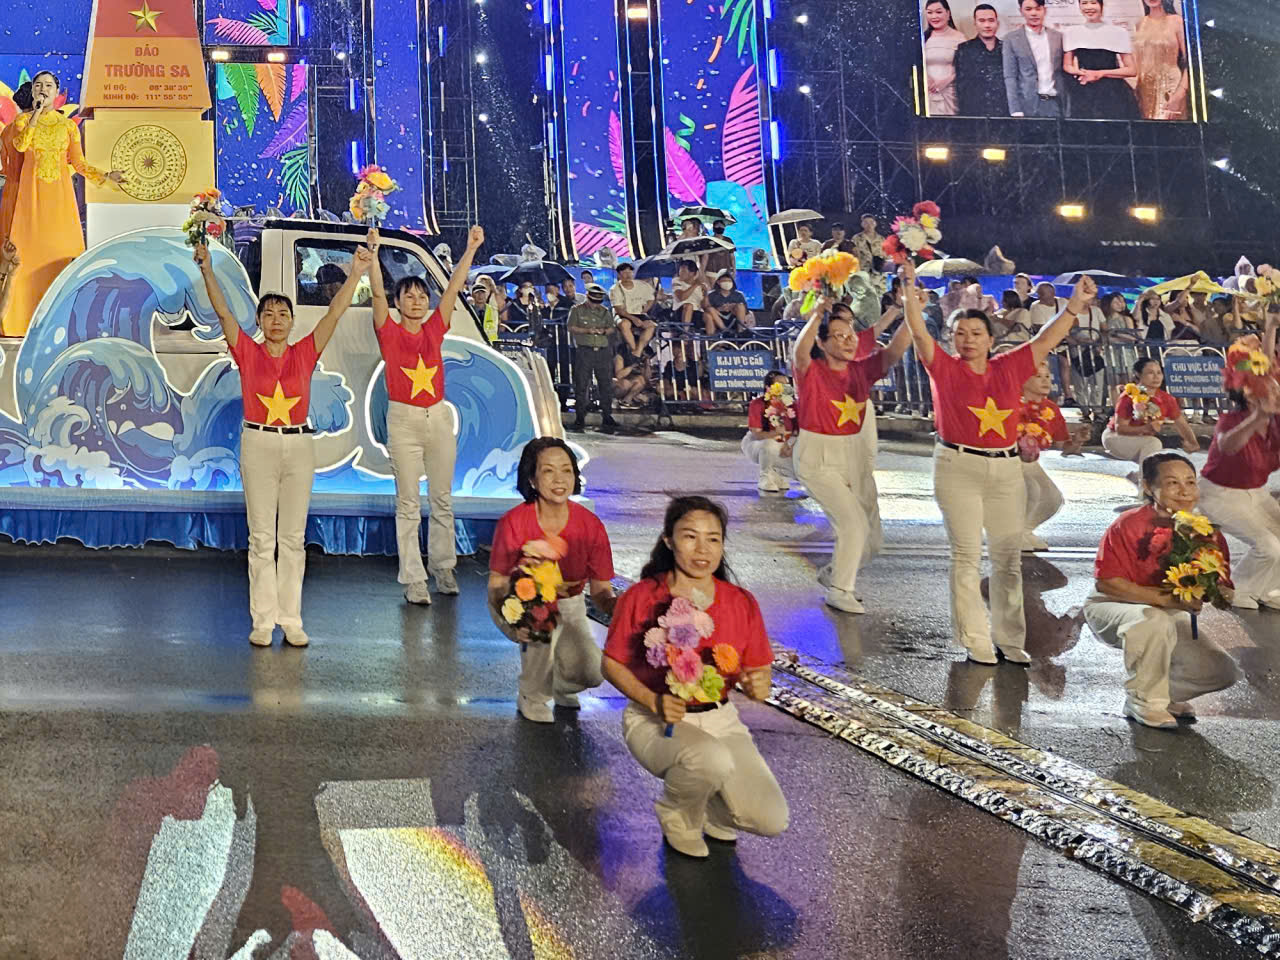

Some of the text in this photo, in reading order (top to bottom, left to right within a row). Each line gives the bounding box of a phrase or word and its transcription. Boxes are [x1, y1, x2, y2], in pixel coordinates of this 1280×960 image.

[134, 43, 160, 57] ĐẢO
[104, 61, 191, 78] TRƯỜNG SA
